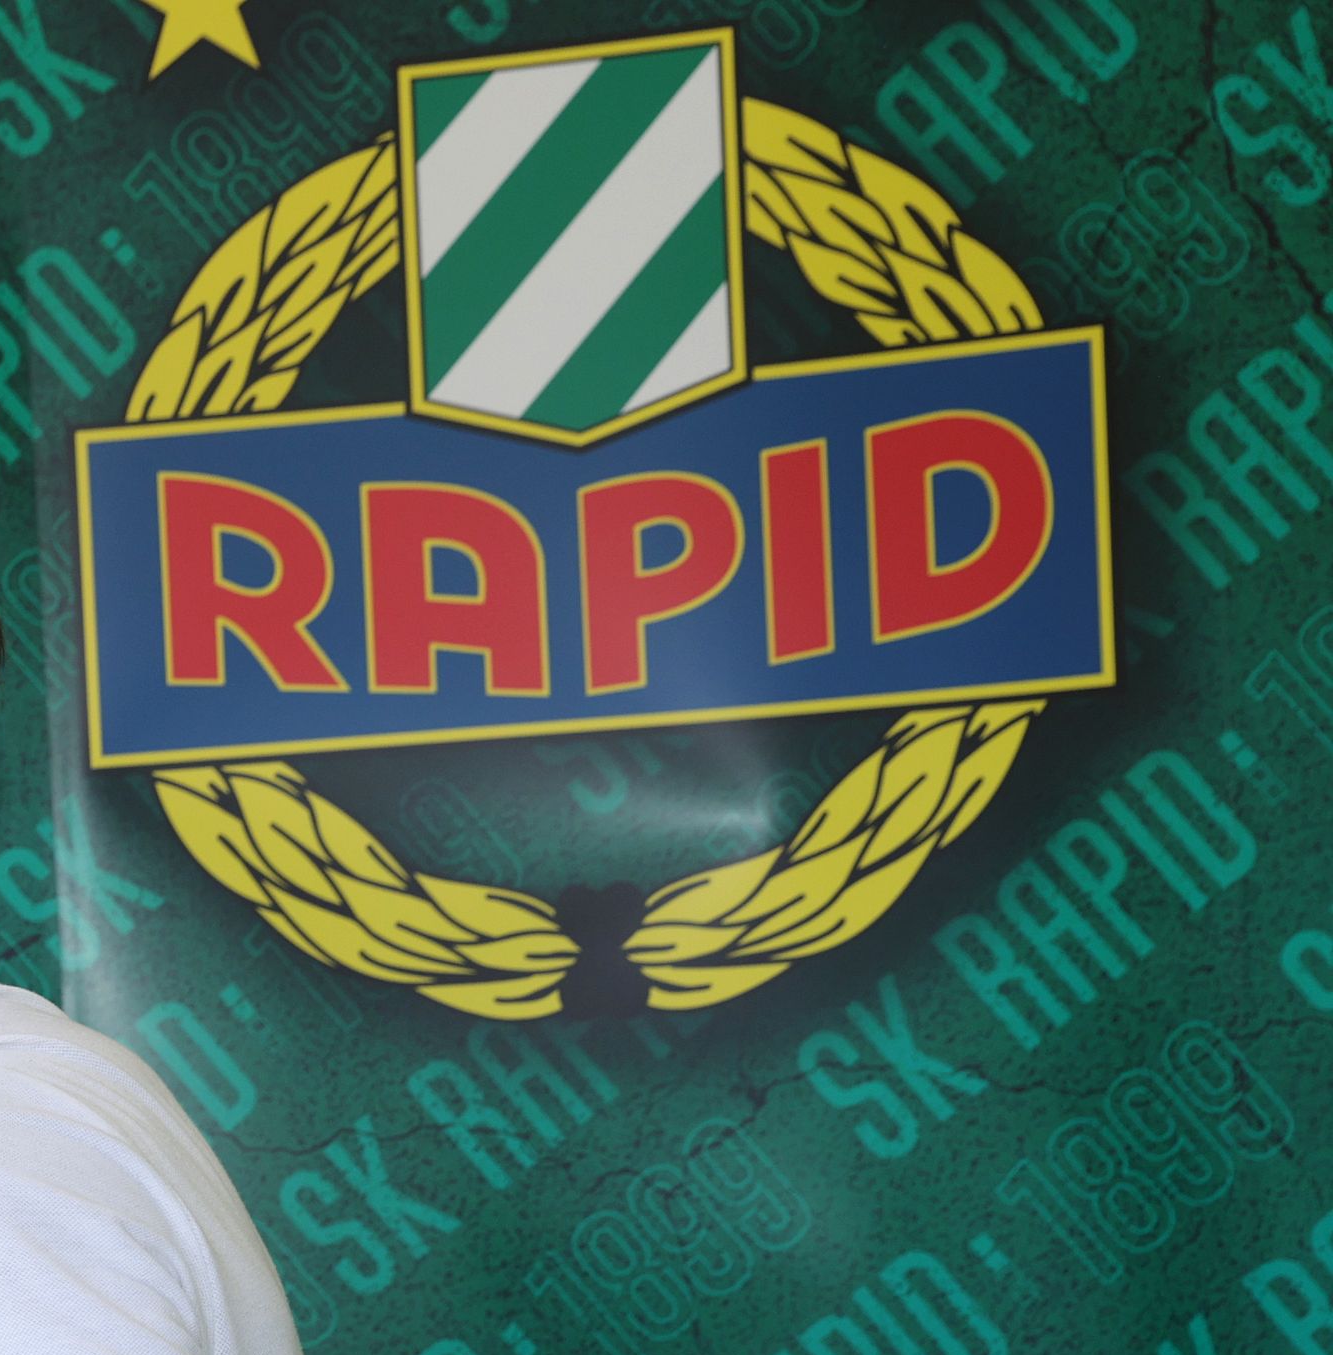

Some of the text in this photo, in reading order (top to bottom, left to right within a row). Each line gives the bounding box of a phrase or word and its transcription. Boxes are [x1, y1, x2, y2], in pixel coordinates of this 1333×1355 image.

[875, 0, 1139, 208] APID
[156, 408, 1056, 698] RAPID
[797, 975, 990, 1159] SK
[994, 1019, 1296, 1286] 1899
[278, 1113, 463, 1295] SK
